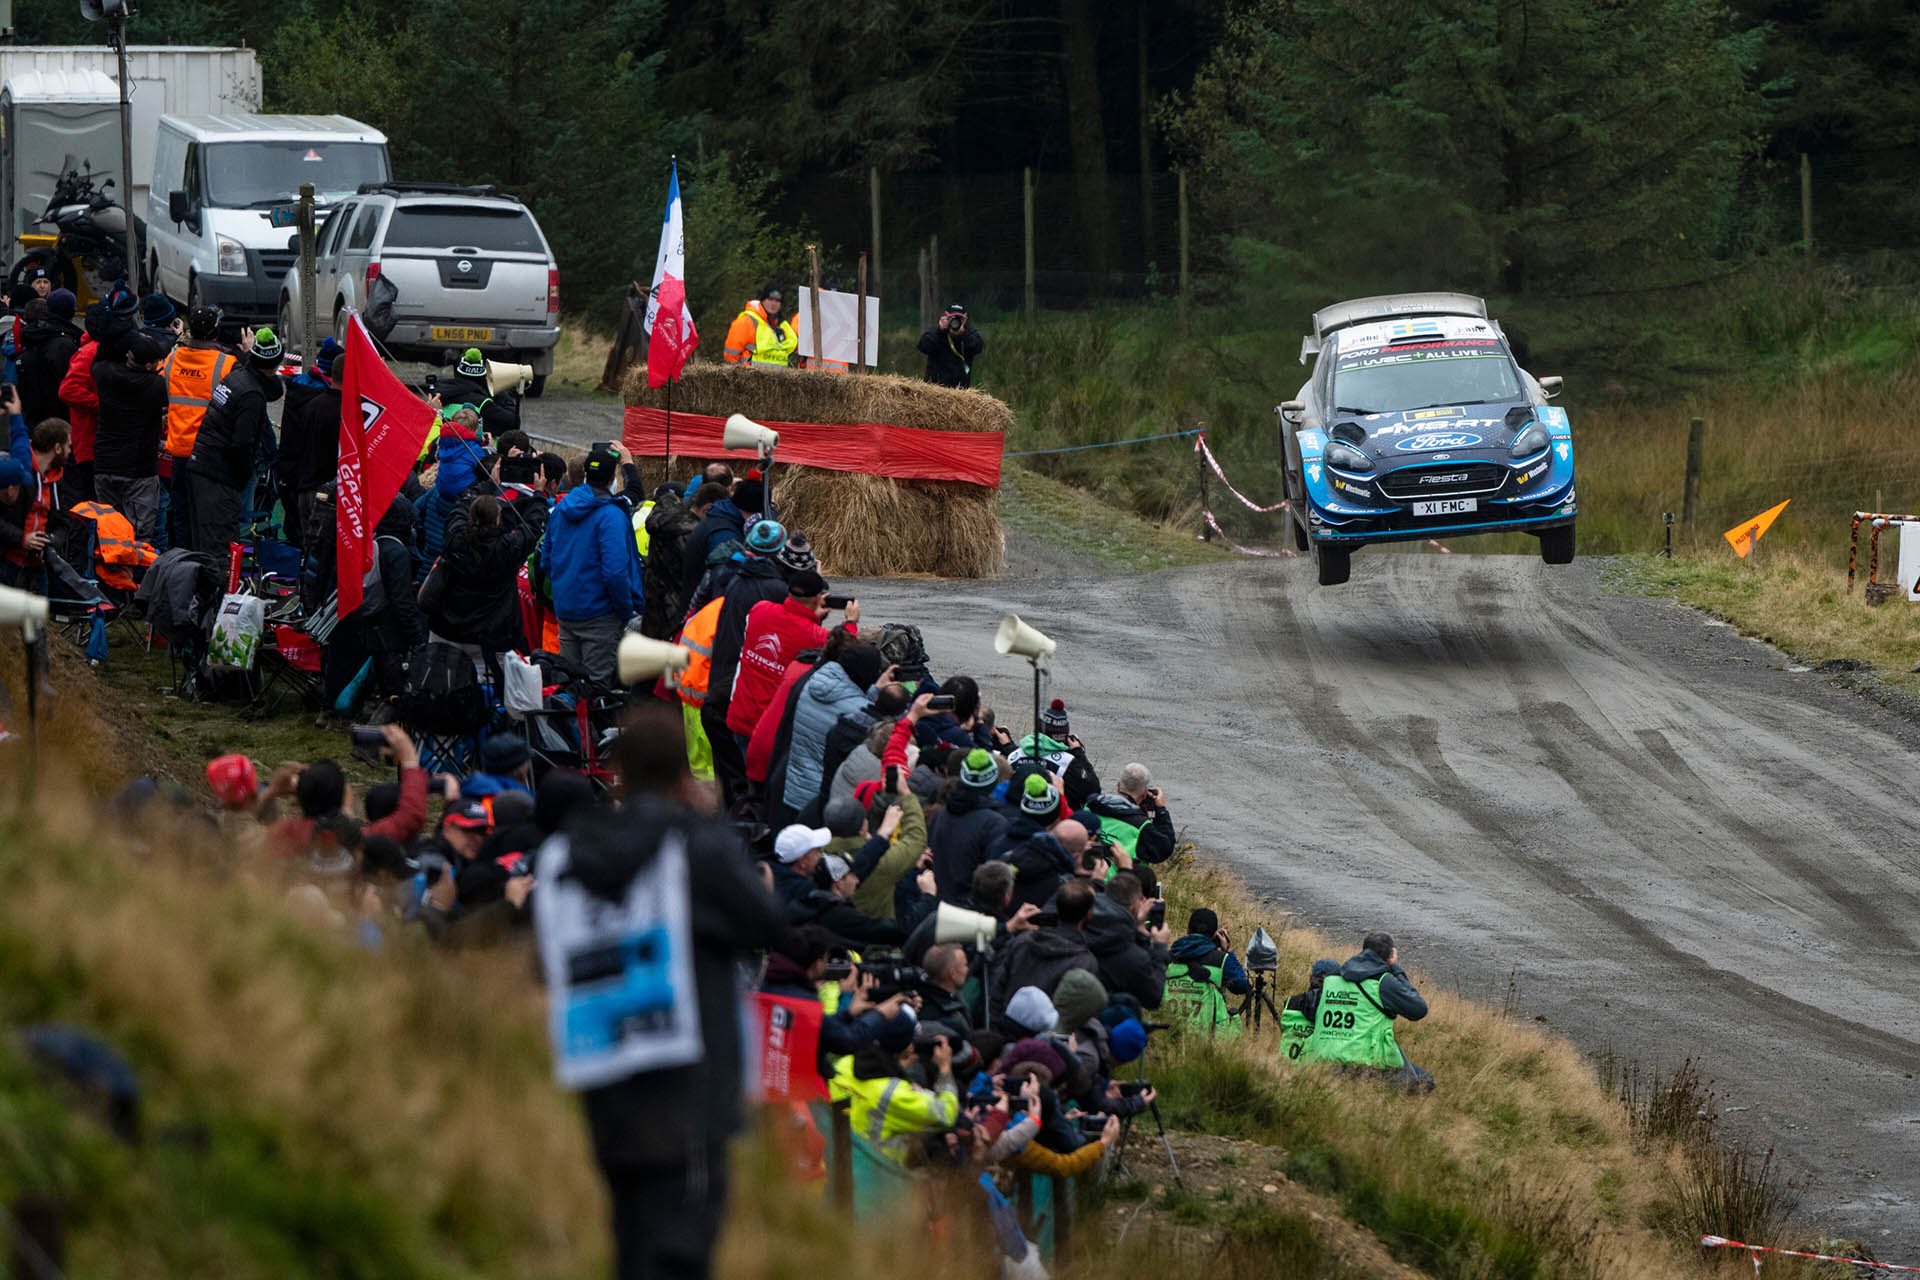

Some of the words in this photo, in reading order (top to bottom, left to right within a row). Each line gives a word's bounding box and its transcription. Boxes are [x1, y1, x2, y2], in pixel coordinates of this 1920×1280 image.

[1339, 349, 1379, 361] FORD
[1381, 340, 1496, 353] PERFORMANCE
[1426, 352, 1446, 360] ALL
[1452, 350, 1479, 358] LIVE
[1411, 434, 1467, 448] Ford
[1441, 501, 1465, 512] FMC
[1323, 1010, 1355, 1029] 029
